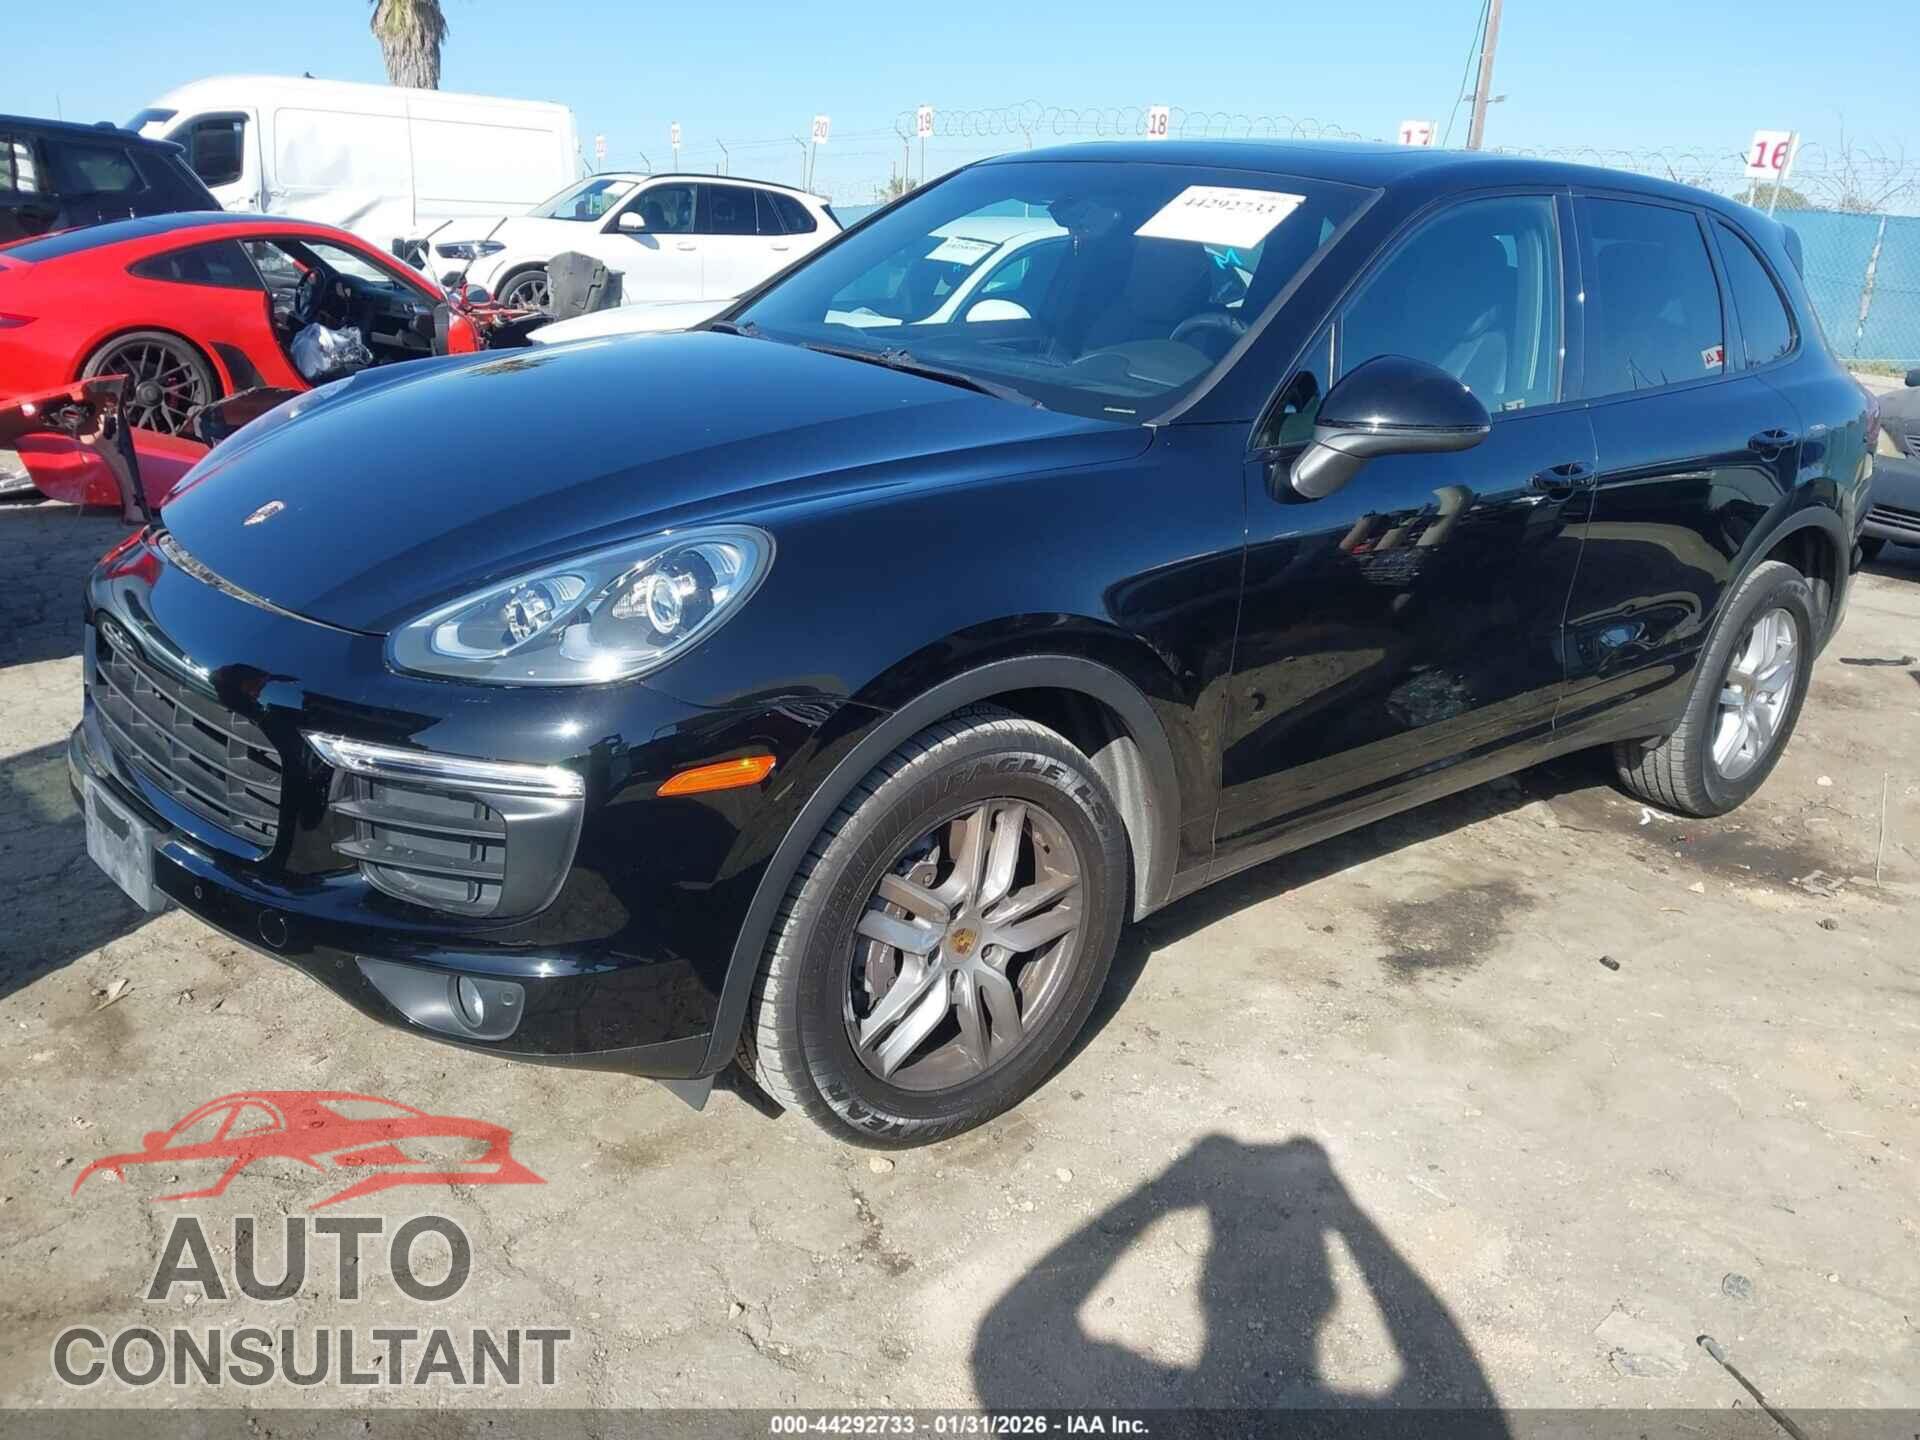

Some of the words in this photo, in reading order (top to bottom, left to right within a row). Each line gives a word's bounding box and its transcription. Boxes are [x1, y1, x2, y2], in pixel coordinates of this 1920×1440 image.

[814, 120, 828, 138] 20
[919, 112, 932, 132] 19
[1150, 113, 1168, 135] 18
[1402, 129, 1430, 145] 17
[1751, 141, 1789, 169] 16
